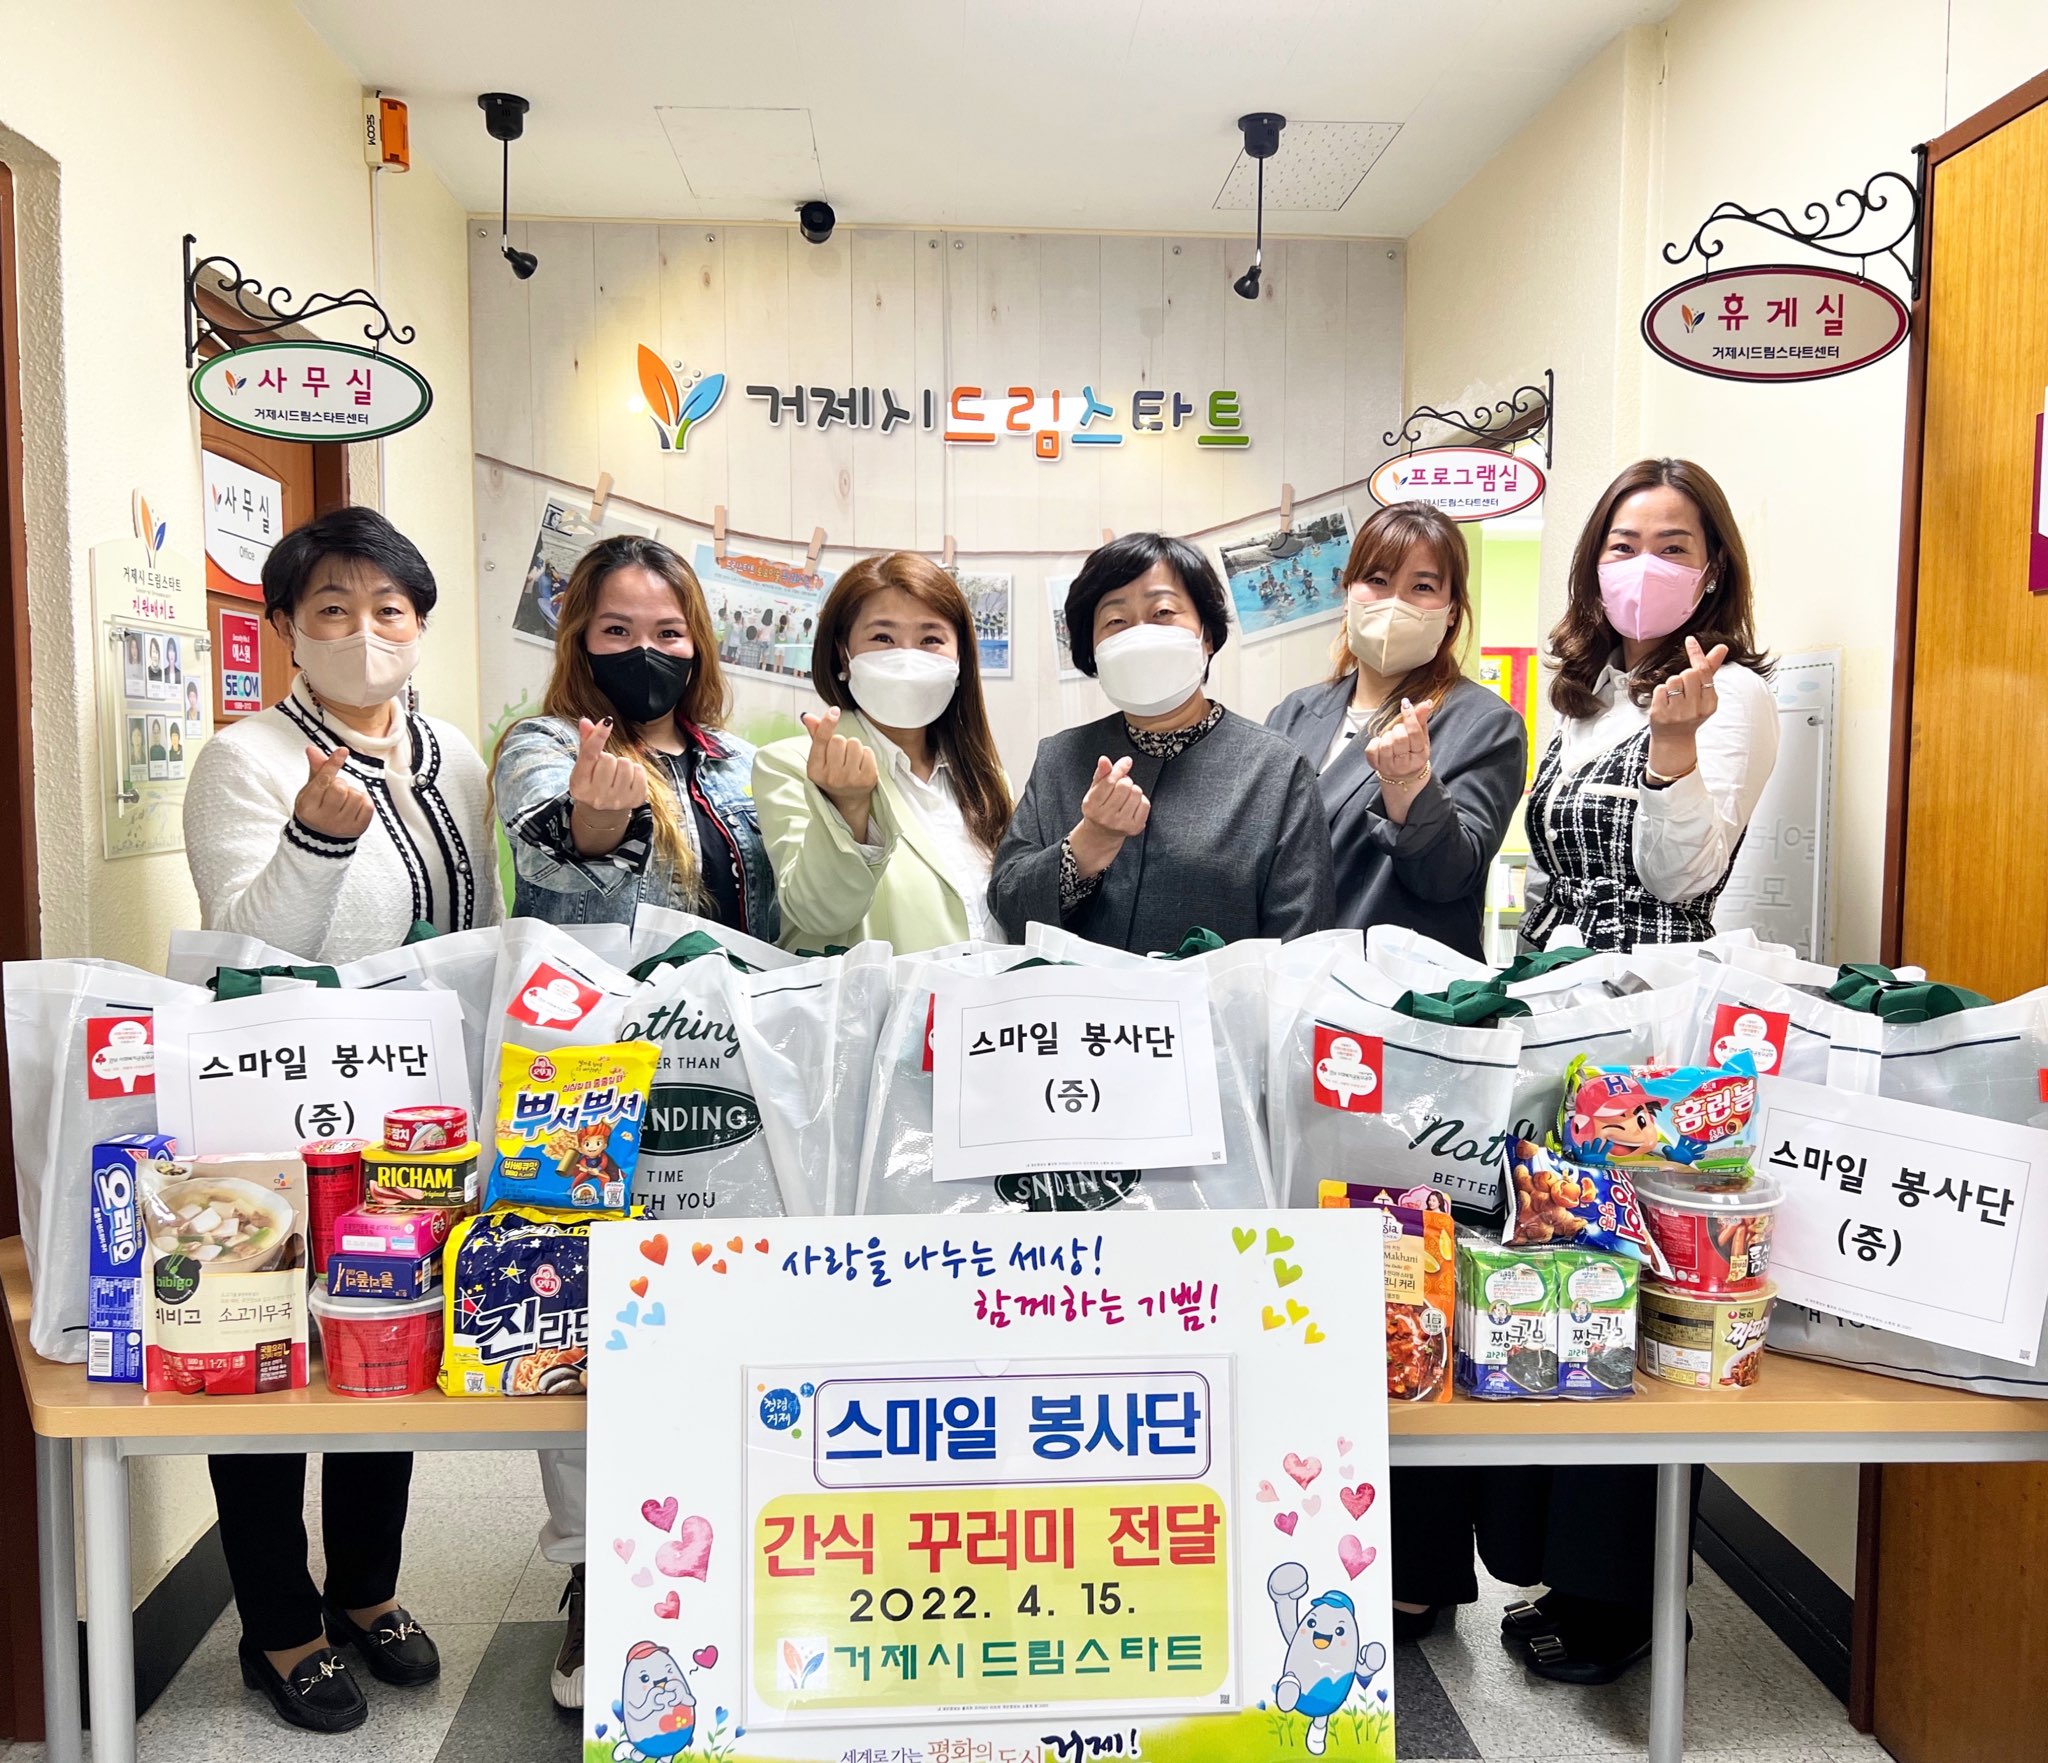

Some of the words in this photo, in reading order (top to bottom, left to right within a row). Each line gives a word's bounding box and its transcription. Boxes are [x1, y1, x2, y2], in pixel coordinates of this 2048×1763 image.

[366, 114, 376, 146] SECOM
[1712, 346, 1840, 360] 거제시드림스타트센터
[254, 408, 369, 425] 거제시드림스타트센터
[1408, 464, 1518, 492] 프로그램실
[225, 485, 270, 535] 사무실
[240, 545, 255, 561] Office
[225, 674, 259, 698] SECOM
[620, 1000, 741, 1059] othing
[968, 1021, 1060, 1057] 스마일
[1080, 1021, 1175, 1059] 봉사단
[198, 1044, 308, 1081] 스마일
[331, 1043, 429, 1079] 봉사단
[678, 1056, 720, 1069] THAN
[1045, 1078, 1100, 1113] (증)
[1602, 1075, 1631, 1097] H
[294, 1100, 356, 1138] (증)
[511, 1086, 641, 1139] 뿌셔뿌셔
[645, 1105, 748, 1132] NDING
[1673, 1078, 1756, 1135] 홈런볼
[377, 1166, 453, 1189] RICHAM
[646, 1169, 684, 1183] TIME
[1432, 1171, 1498, 1197] BETTER
[1768, 1140, 1868, 1195] 스마일
[1891, 1167, 2015, 1227] 봉사단
[98, 1168, 136, 1263] 오레오
[630, 1193, 665, 1211] ITH
[676, 1191, 716, 1211] YOU
[1598, 1202, 1617, 1231] 땅콩
[1837, 1218, 1902, 1268] (증)
[781, 1236, 892, 1288] 사랑을
[904, 1240, 997, 1279] 나누는
[1008, 1235, 1103, 1276] 세상!
[156, 1276, 194, 1292] bibigo
[1399, 1279, 1415, 1291] 커리
[218, 1302, 293, 1324] 소고기무국
[974, 1284, 1125, 1329] 함께하는
[1137, 1280, 1219, 1333] 기쁨!
[1490, 1317, 1545, 1349] 짱구김
[1725, 1316, 1770, 1350] 짜파
[824, 1396, 998, 1463] 스마일
[1027, 1391, 1201, 1460] 봉사단
[762, 1512, 874, 1578] 간식
[907, 1507, 1075, 1574] 꾸러미
[1107, 1503, 1221, 1567] 전달
[848, 1584, 991, 1624] 2022.
[1016, 1583, 1055, 1618] 4.
[1080, 1581, 1136, 1617] 15.
[927, 1737, 993, 1763] 평화의
